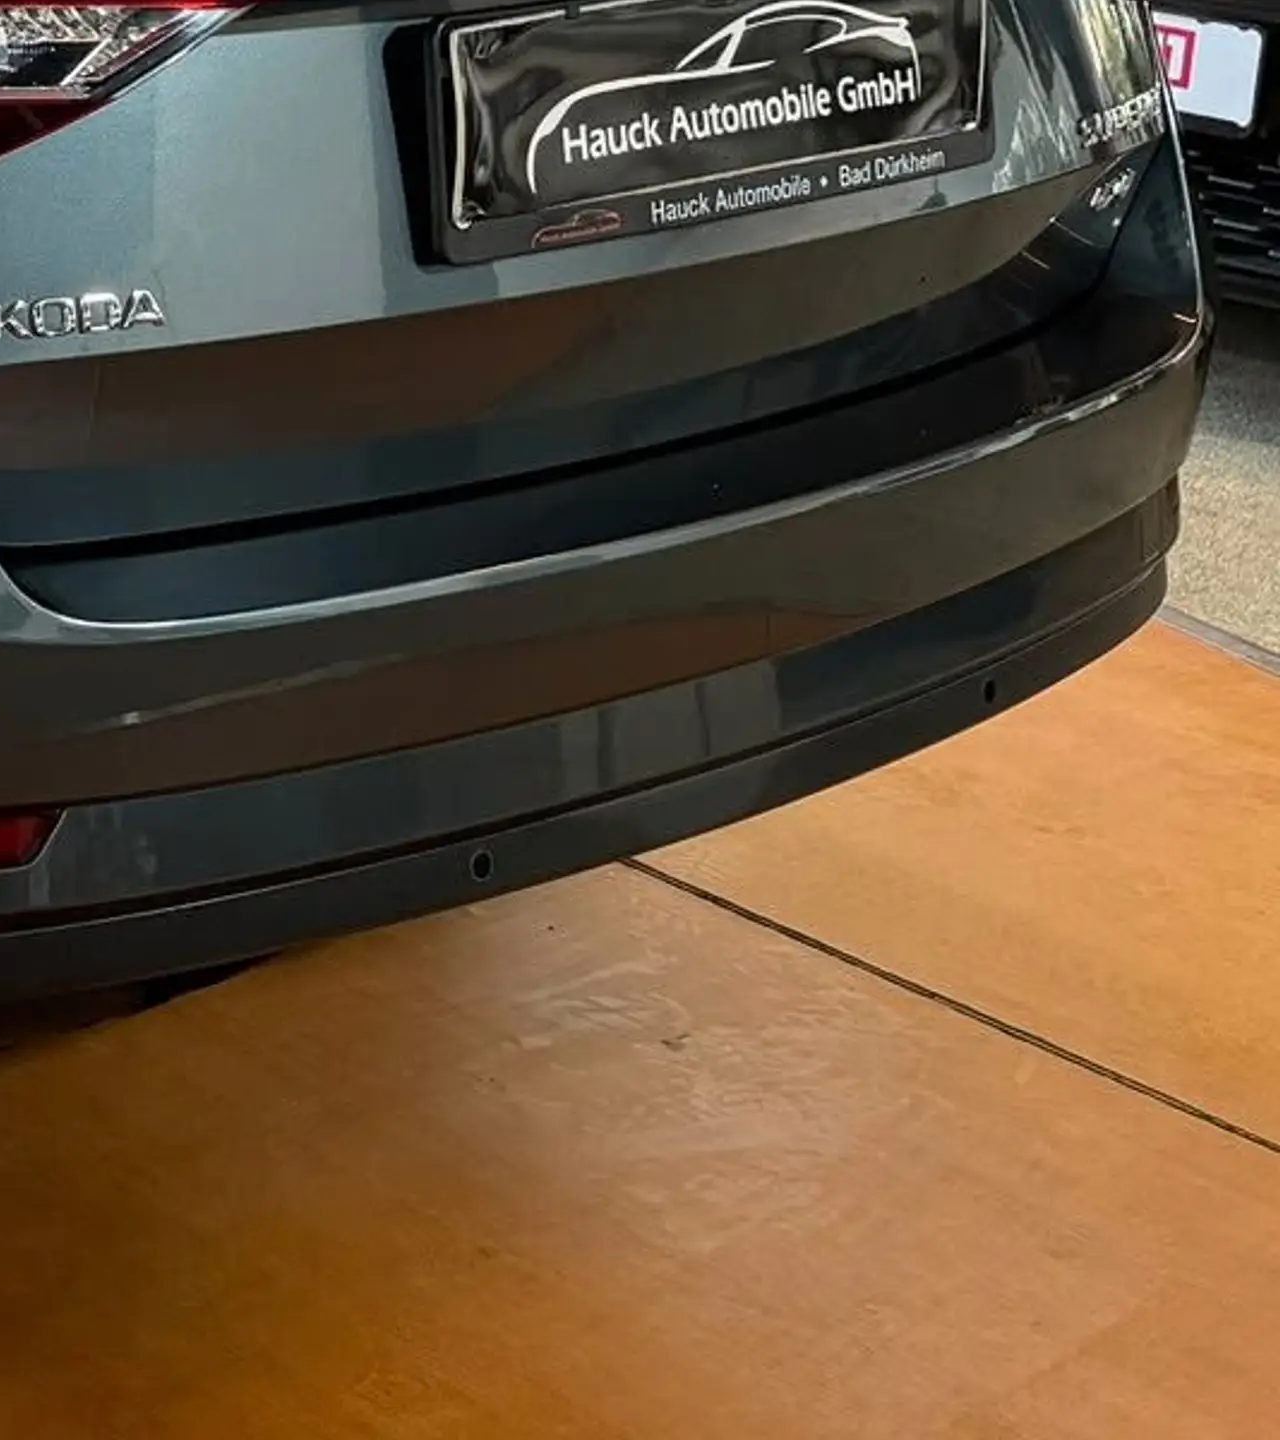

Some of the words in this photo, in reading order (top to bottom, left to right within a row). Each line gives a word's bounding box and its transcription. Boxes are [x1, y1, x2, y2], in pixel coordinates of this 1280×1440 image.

[561, 116, 664, 164] Hauck
[669, 83, 833, 144] Automobile
[837, 67, 917, 114] GmbH
[650, 191, 711, 224] Hauck
[715, 174, 812, 214] Automobile
[838, 163, 872, 188] Bad
[874, 148, 946, 184] Dürkheim
